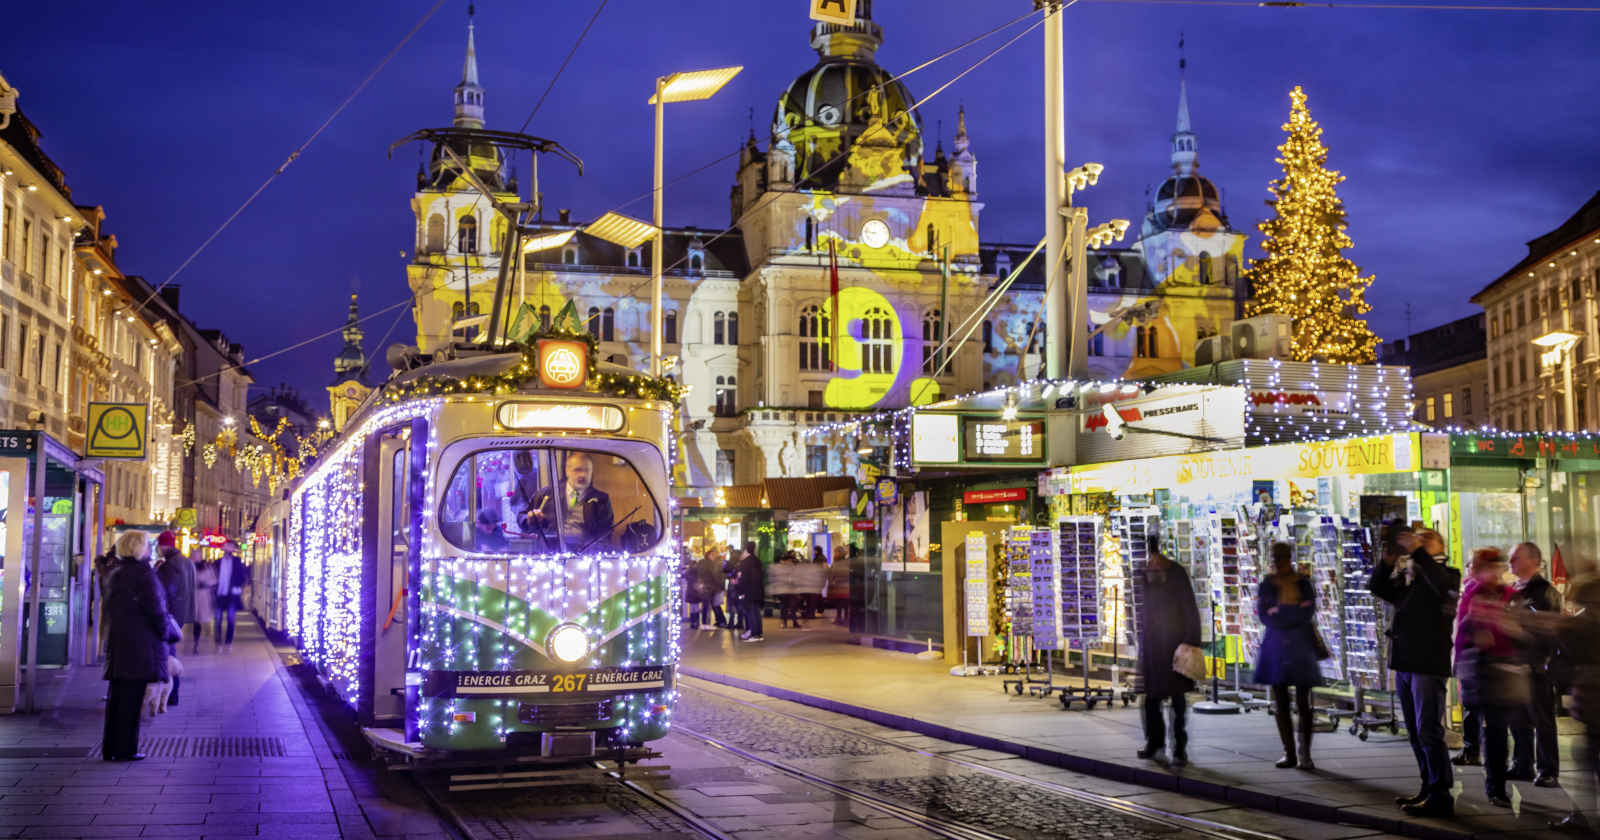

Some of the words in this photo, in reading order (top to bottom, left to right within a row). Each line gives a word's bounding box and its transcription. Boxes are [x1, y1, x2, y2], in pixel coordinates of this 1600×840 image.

[1477, 439, 1495, 451] WC
[1298, 442, 1389, 471] SOUVENIR
[464, 675, 512, 687] ENERGIE
[515, 674, 546, 685] GRAZ
[552, 674, 587, 692] 267
[595, 672, 639, 684] ENERGIE
[642, 671, 664, 681] GRAZ
